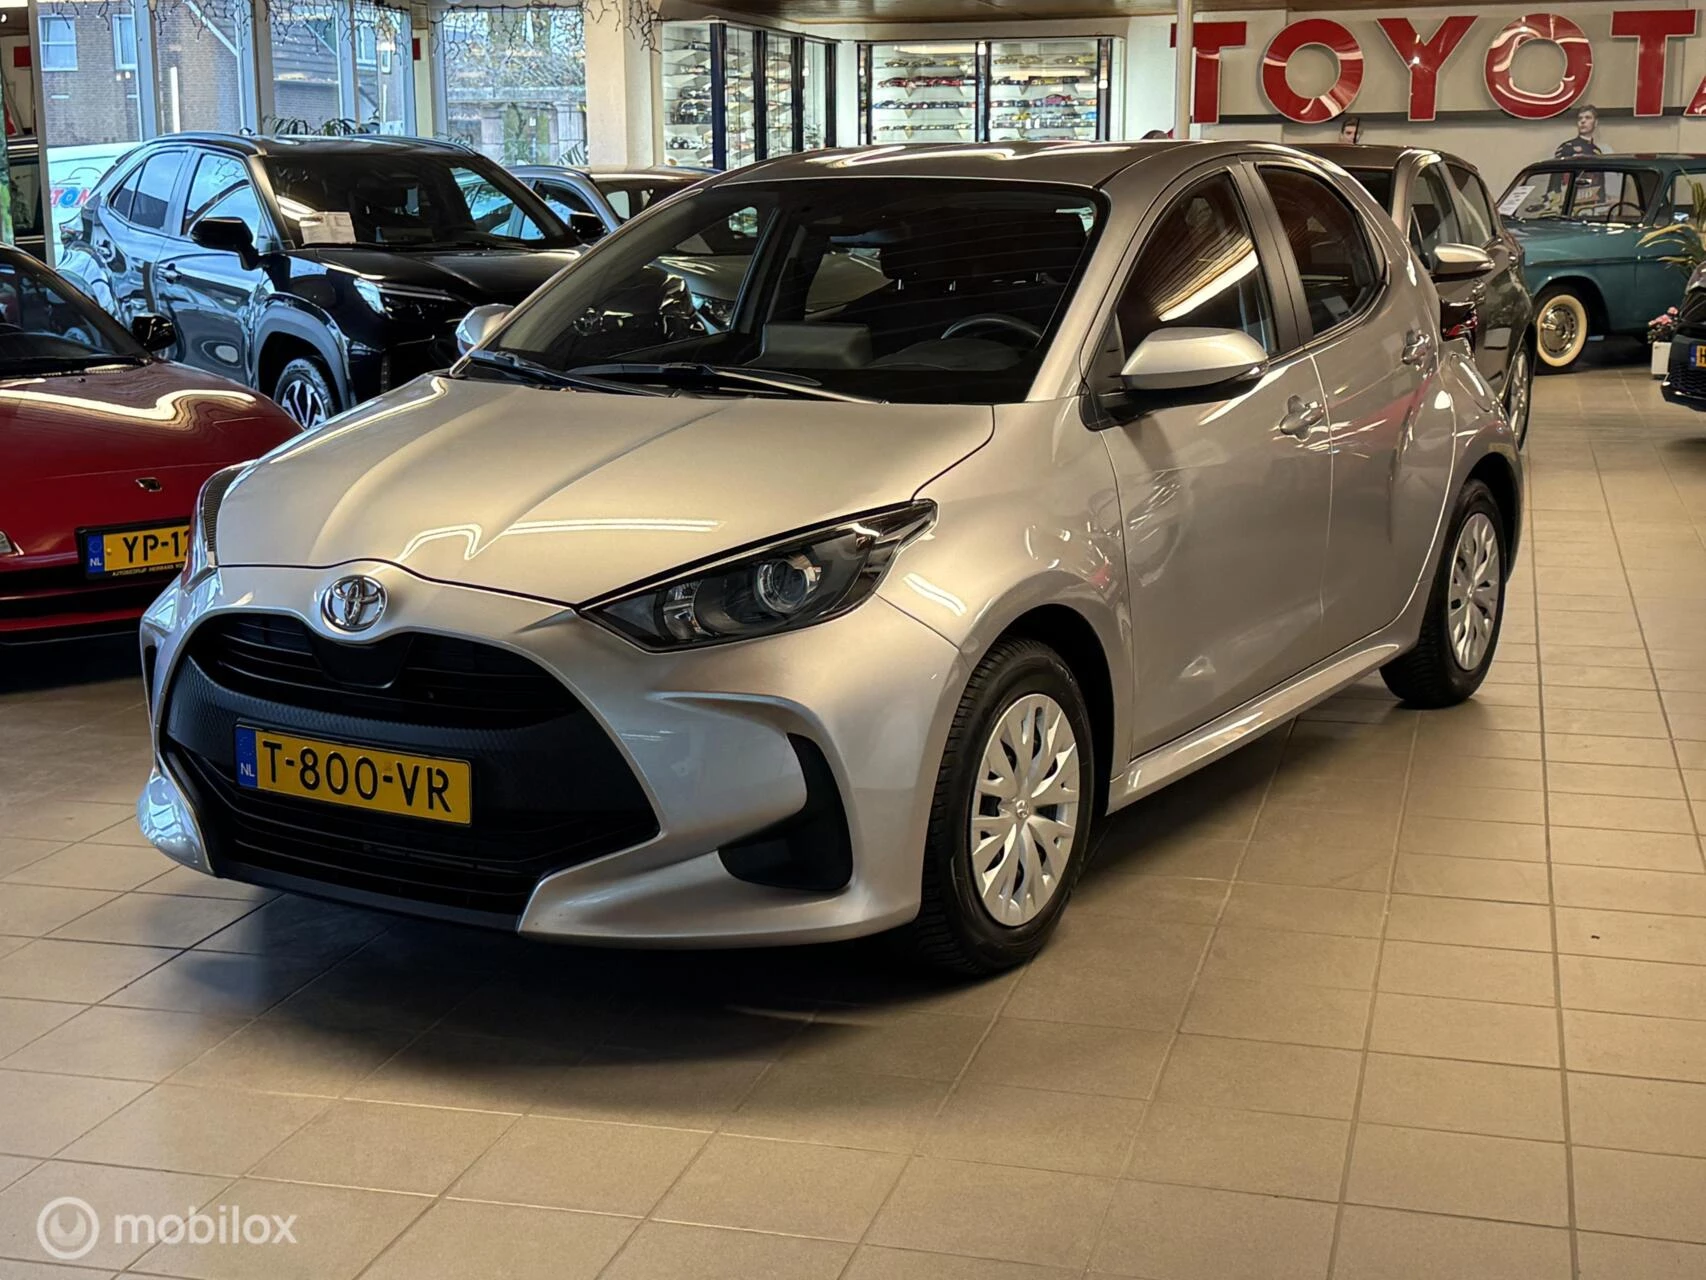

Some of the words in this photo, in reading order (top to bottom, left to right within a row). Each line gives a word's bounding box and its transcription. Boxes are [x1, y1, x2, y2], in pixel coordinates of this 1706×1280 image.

[1169, 9, 1706, 124] TOYOT
[89, 558, 102, 567] NL
[240, 762, 255, 778] NL
[261, 740, 452, 813] T-800-VR
